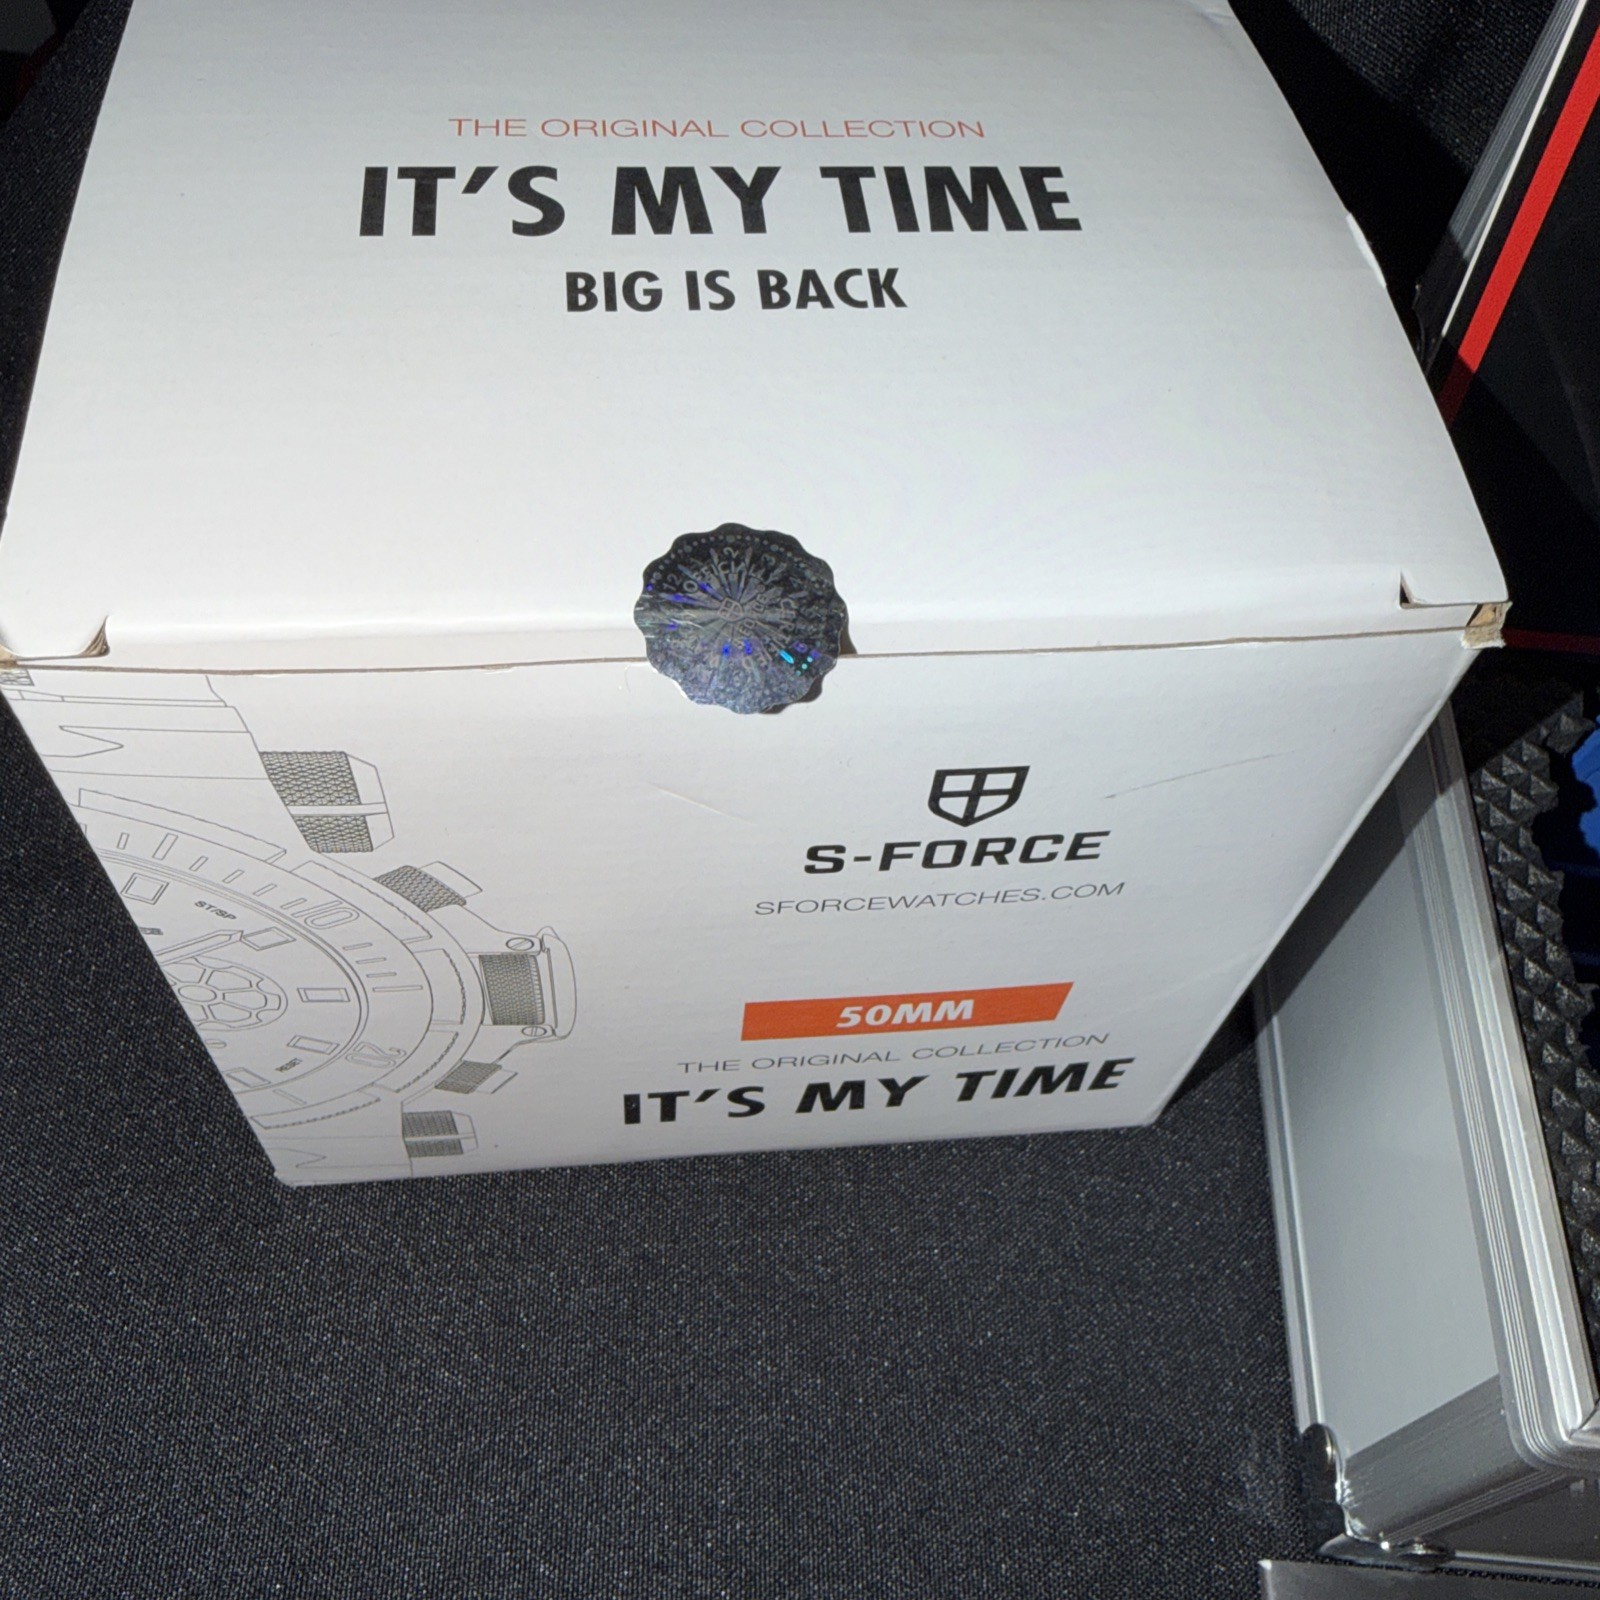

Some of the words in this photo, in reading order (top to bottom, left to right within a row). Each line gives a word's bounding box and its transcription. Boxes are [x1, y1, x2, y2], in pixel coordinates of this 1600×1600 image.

[450, 118, 527, 138] THE
[541, 118, 727, 138] ORIGINAL
[740, 120, 985, 138] COLLECTION
[359, 165, 566, 237] IT'S
[611, 166, 781, 236] MY
[820, 165, 1083, 233] TIME
[565, 270, 663, 313] BIG
[686, 269, 736, 311] IS
[757, 267, 908, 310] BACK
[803, 829, 1112, 875] S-FORCE
[194, 900, 237, 920] ST/SP
[754, 881, 1126, 916] SFORCEWATCHES.COM
[835, 998, 975, 1029] 50MM
[678, 1060, 741, 1075] THE
[751, 1050, 901, 1071] ORIGINAL
[912, 1033, 1110, 1060] COLLECTION
[623, 1086, 765, 1126] IT'S
[794, 1074, 931, 1115] MY
[955, 1056, 1137, 1103] TIME
